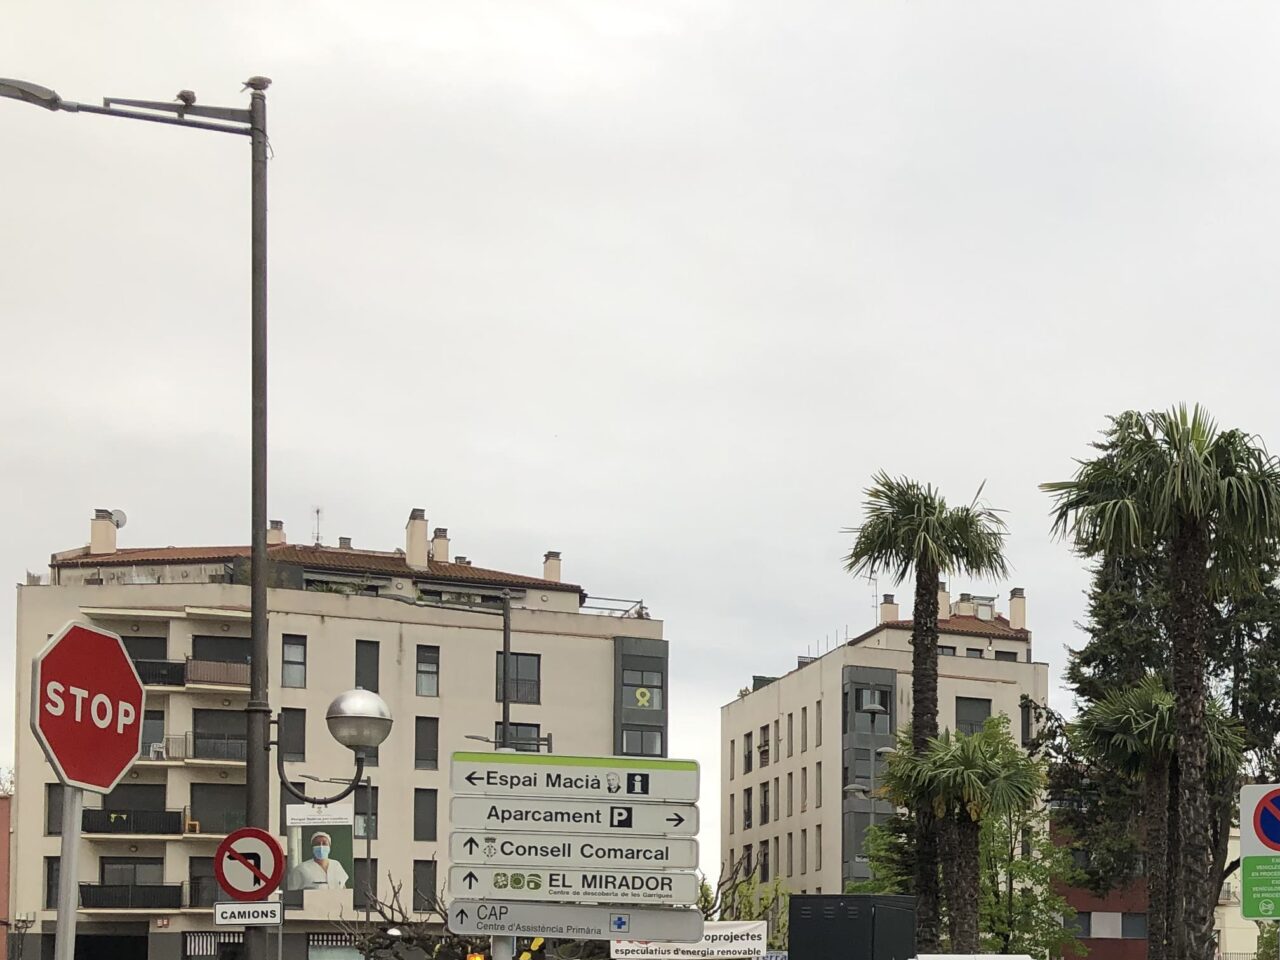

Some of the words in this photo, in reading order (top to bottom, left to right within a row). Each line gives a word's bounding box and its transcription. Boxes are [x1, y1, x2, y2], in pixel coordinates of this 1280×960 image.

[45, 681, 136, 734] STOP
[486, 771, 538, 788] Espai
[545, 773, 601, 789] Macià
[487, 805, 602, 824] Aparcament
[500, 841, 572, 858] Consell
[580, 843, 669, 861] Comarcal
[548, 873, 573, 888] EL
[582, 874, 673, 891] MIRADOR
[220, 909, 277, 920] CAMIONS
[477, 904, 509, 921] CAP
[476, 921, 505, 931] Centre
[704, 932, 763, 943] oprojectes
[614, 947, 671, 956] especulatius
[673, 947, 715, 957] d'energia
[716, 947, 761, 956] renovable
